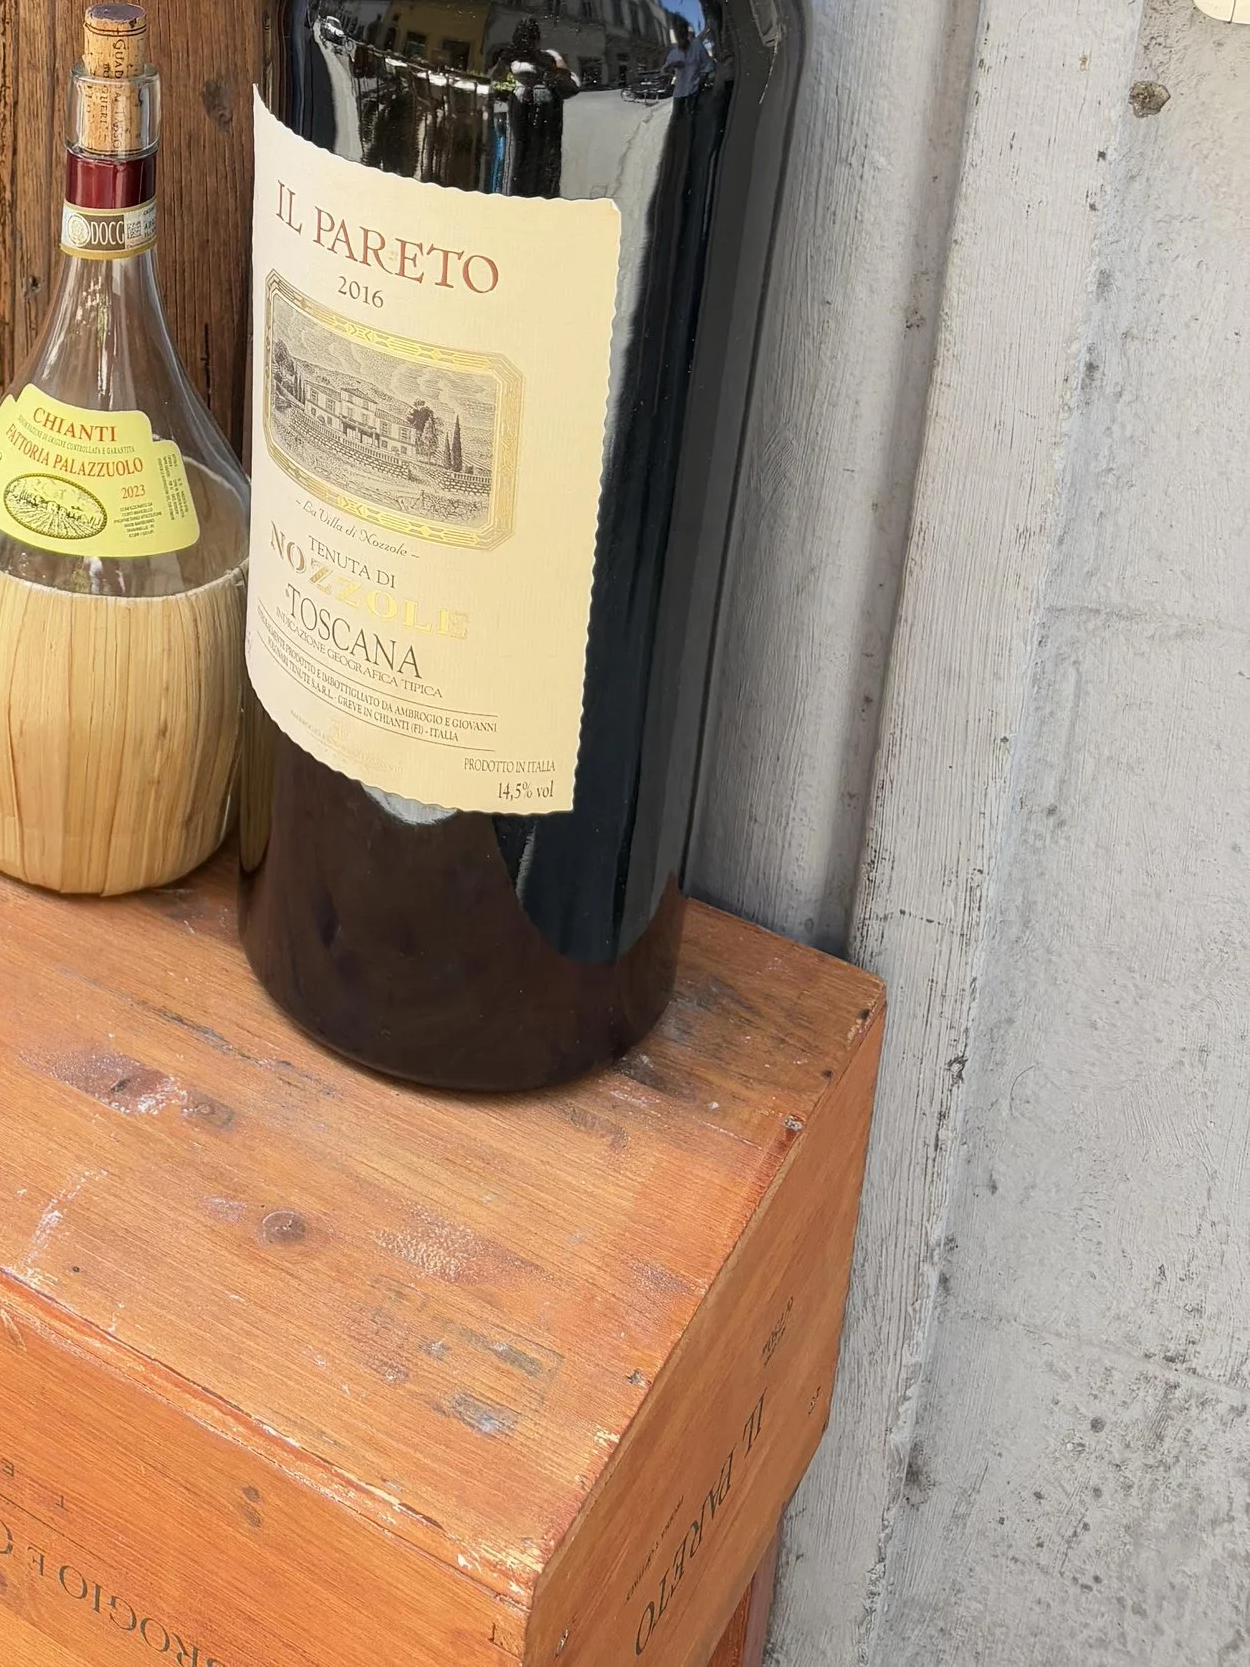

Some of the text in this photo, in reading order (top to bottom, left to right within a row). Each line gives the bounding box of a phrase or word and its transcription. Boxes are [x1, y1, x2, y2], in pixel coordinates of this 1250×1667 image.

[91, 221, 125, 245] DOCG
[276, 180, 499, 294] IL PARETO
[338, 275, 384, 308] 2016
[5, 423, 49, 466] FATTORIA
[53, 454, 143, 478] PALAZZUOLO
[33, 407, 117, 442] CHIANTI
[66, 443, 101, 455] CONTROLLATA
[107, 445, 135, 455] GARANTITA
[121, 484, 146, 499] 2023
[317, 509, 343, 533] Villa
[346, 524, 357, 540] di
[359, 530, 408, 557] Nozzole
[270, 520, 470, 639] NOZZOLE
[308, 535, 396, 589] TENUTA DI
[276, 606, 326, 654] INDICAZIONE
[327, 648, 398, 687] GEOGRAFICA
[402, 679, 443, 698] TIPICA
[286, 583, 422, 679] TOSCANA
[286, 644, 316, 674] PRODOTTO
[316, 667, 321, 679] E
[321, 669, 380, 708] IMBOTTIGLIATO
[381, 697, 393, 712] DA
[394, 705, 443, 725] AMBROGIO
[445, 717, 450, 727] E
[452, 718, 497, 732] GIOVANNI
[289, 660, 312, 685] TENUTE
[337, 695, 362, 714] GREVE
[363, 706, 373, 719] IN
[374, 710, 410, 731] CHIANTI
[411, 723, 424, 736] (FI)
[430, 727, 459, 742] ITALIA
[464, 758, 556, 773] PRODOTTO IN ITALIA
[498, 780, 554, 801] 14,5% vol
[743, 1387, 768, 1458] IL
[27, 1542, 46, 1576] E
[635, 1443, 736, 1657] PARETO
[58, 1565, 227, 1667] ROGIO
